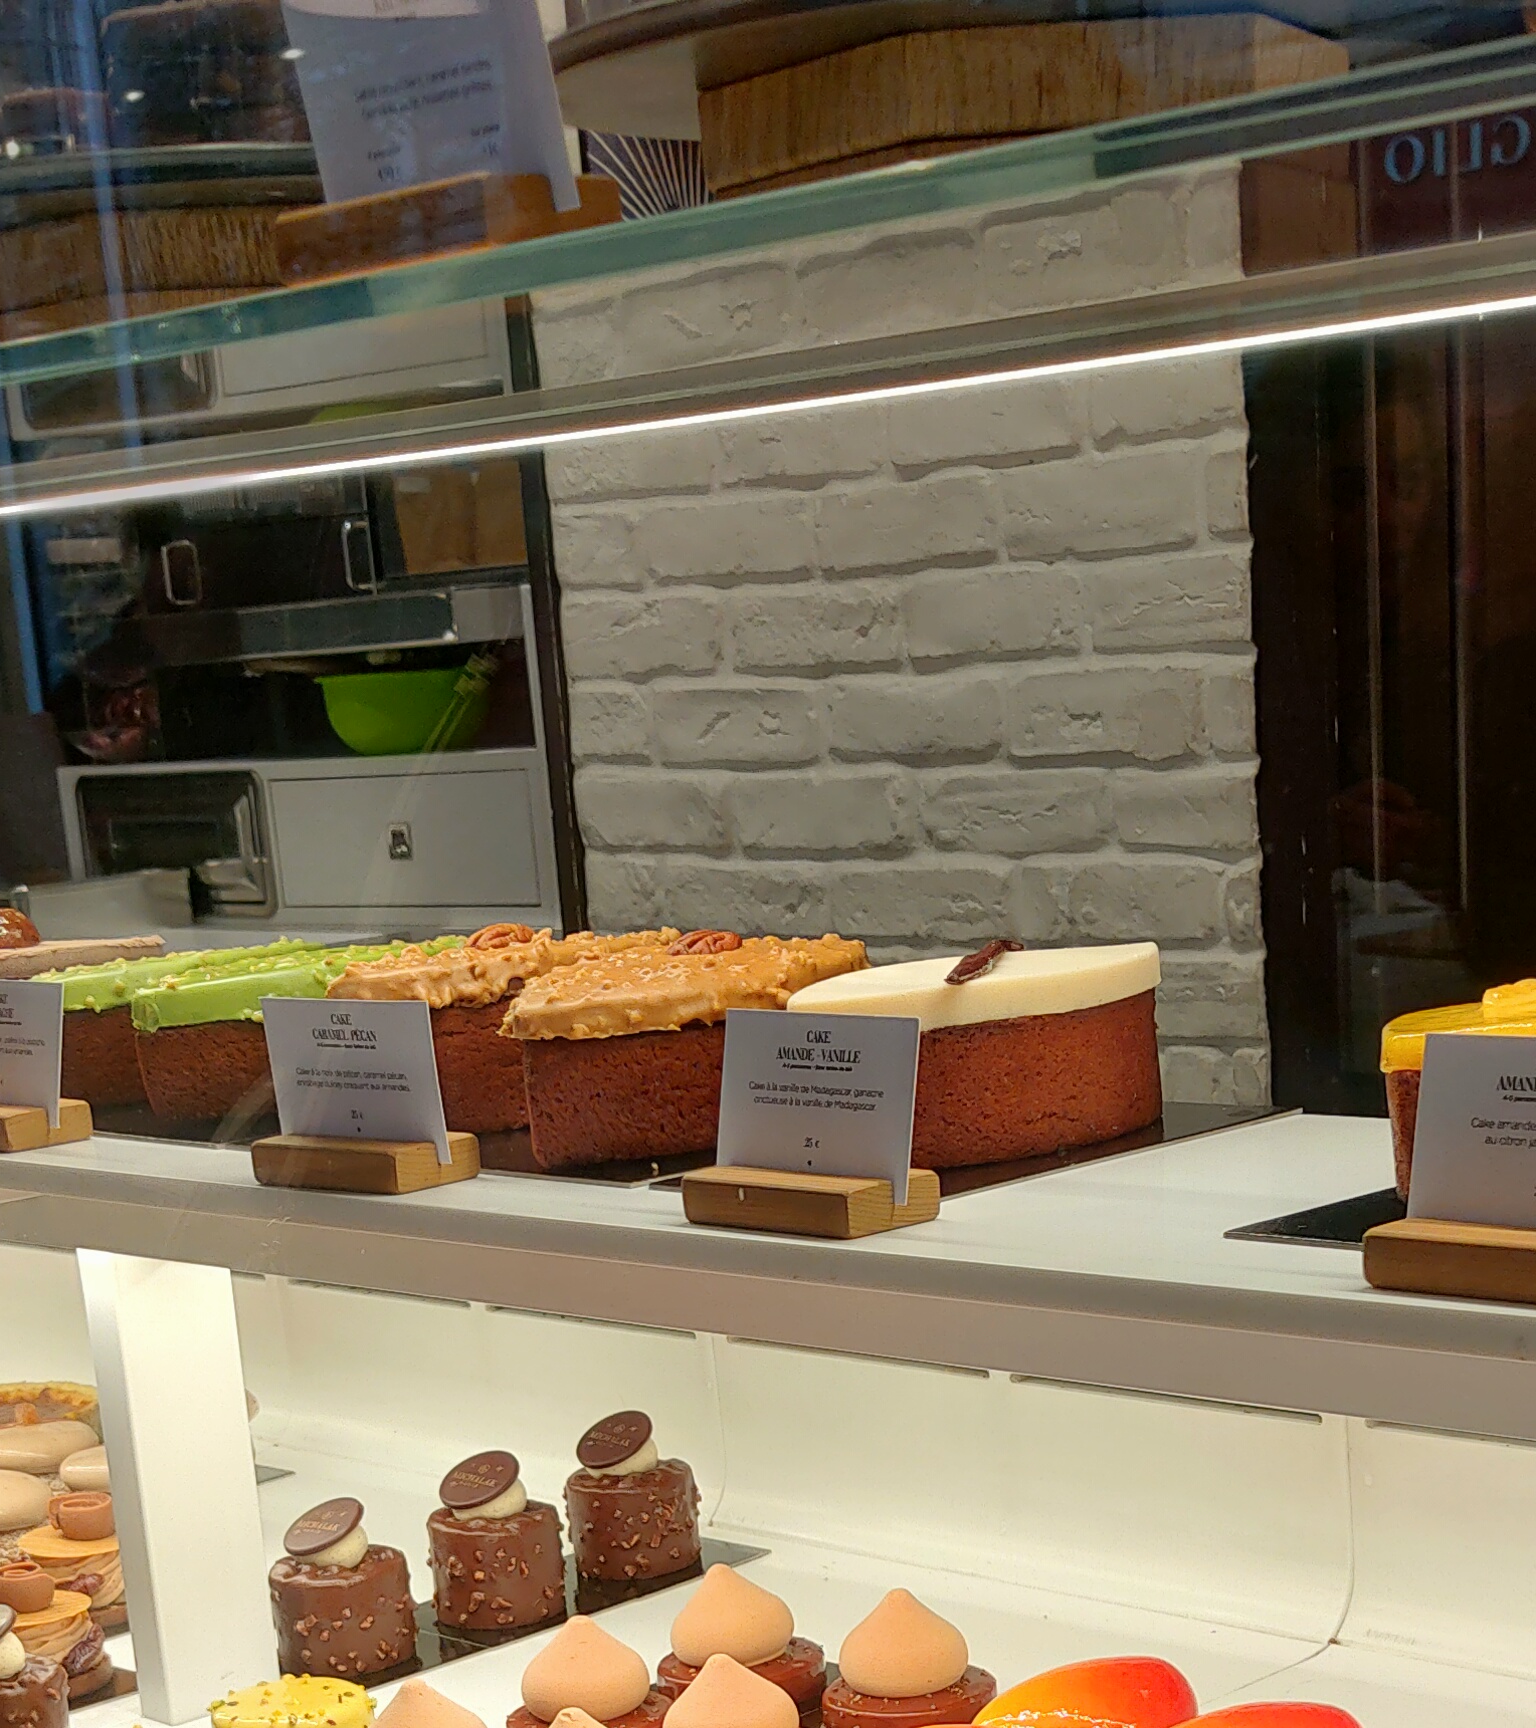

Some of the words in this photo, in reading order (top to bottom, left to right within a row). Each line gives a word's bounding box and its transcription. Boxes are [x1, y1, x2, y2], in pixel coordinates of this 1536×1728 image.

[329, 1012, 352, 1026] CAKE
[311, 1027, 349, 1041] CARAMEL
[805, 1029, 832, 1044] CAKE
[775, 1045, 815, 1062] AMANDE
[820, 1048, 861, 1064] VANILLE
[1469, 1116, 1496, 1129] Cake
[1498, 1135, 1527, 1147] citron
